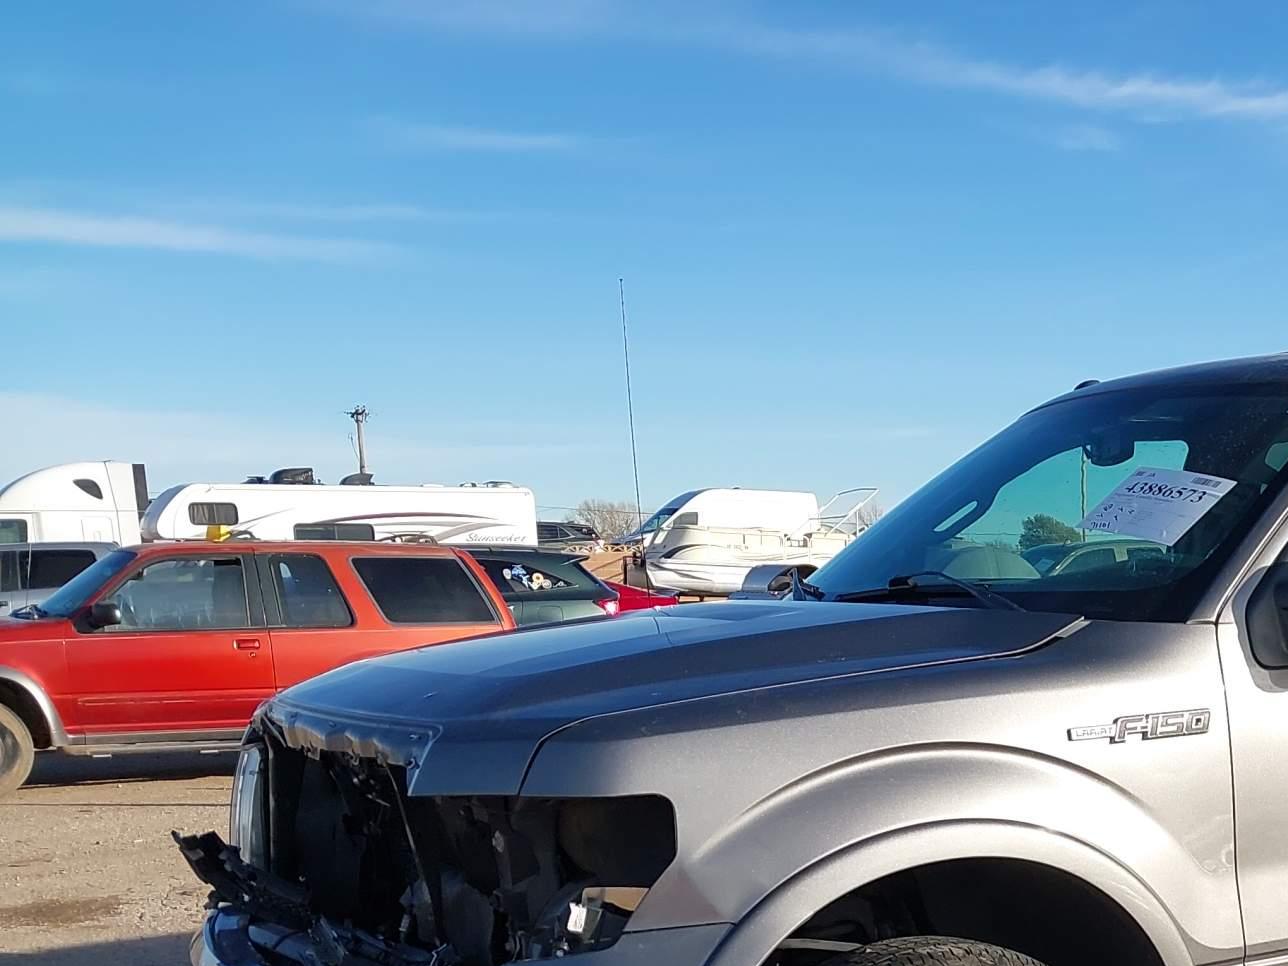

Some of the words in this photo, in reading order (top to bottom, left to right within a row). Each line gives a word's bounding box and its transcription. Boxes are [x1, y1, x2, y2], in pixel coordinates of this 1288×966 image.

[1125, 480, 1207, 503] 43886573
[466, 532, 529, 543] Sunseeker
[1113, 709, 1211, 743] F-150
